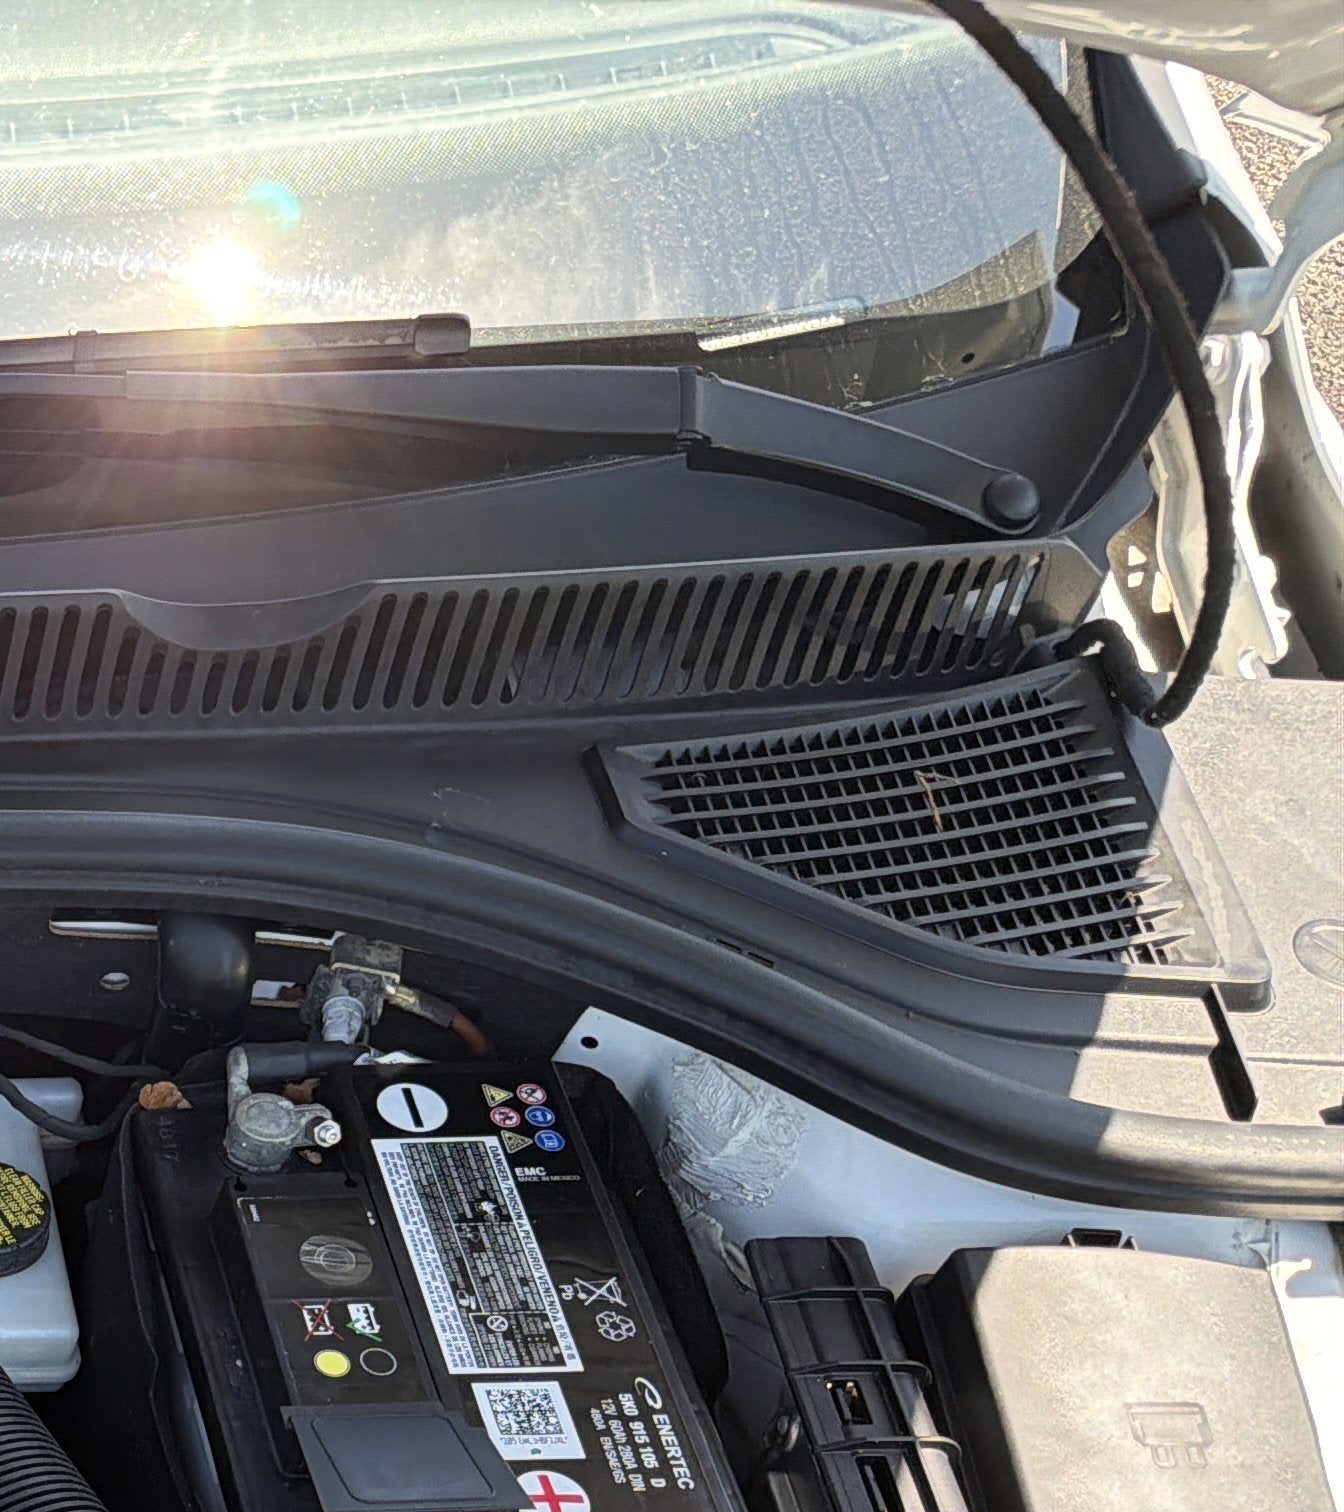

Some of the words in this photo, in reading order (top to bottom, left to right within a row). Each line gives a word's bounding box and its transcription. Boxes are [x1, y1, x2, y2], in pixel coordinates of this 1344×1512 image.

[514, 1167, 547, 1177] EMC
[557, 1284, 574, 1301] Pb
[600, 1398, 618, 1415] 12V
[607, 1419, 628, 1443] 60Ah
[627, 1420, 650, 1443] 915
[638, 1446, 660, 1468] 105
[651, 1414, 696, 1490] ENERTEC
[627, 1473, 647, 1491] DIN
[649, 1478, 667, 1487] D
